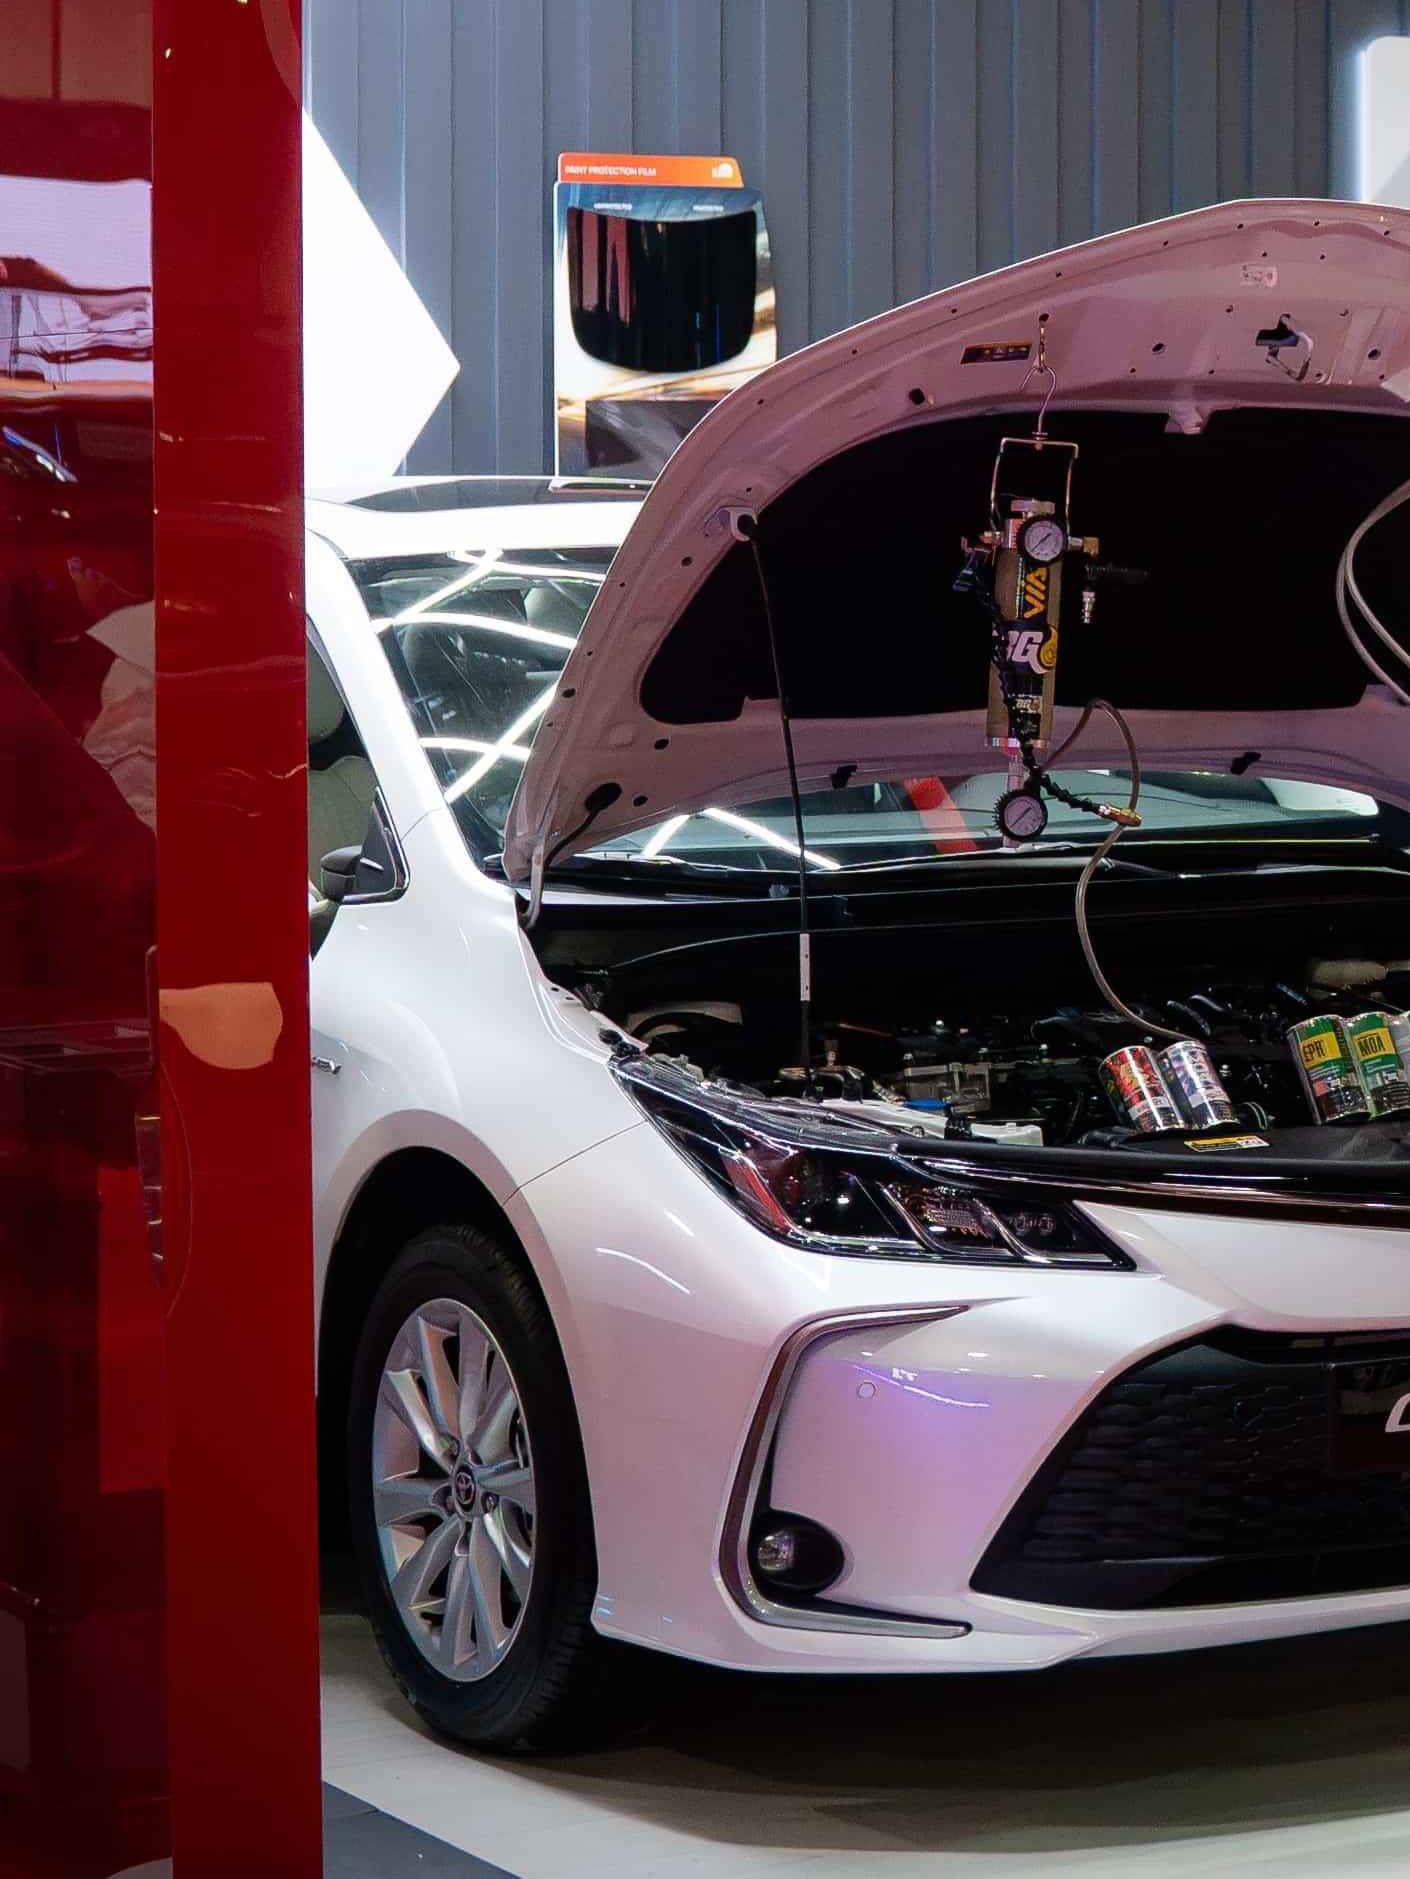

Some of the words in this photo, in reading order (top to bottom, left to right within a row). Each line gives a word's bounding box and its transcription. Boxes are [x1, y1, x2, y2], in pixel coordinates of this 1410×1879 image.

[589, 167, 637, 177] PROTECTION
[638, 168, 657, 177] FILM
[1358, 1035, 1386, 1057] MOA
